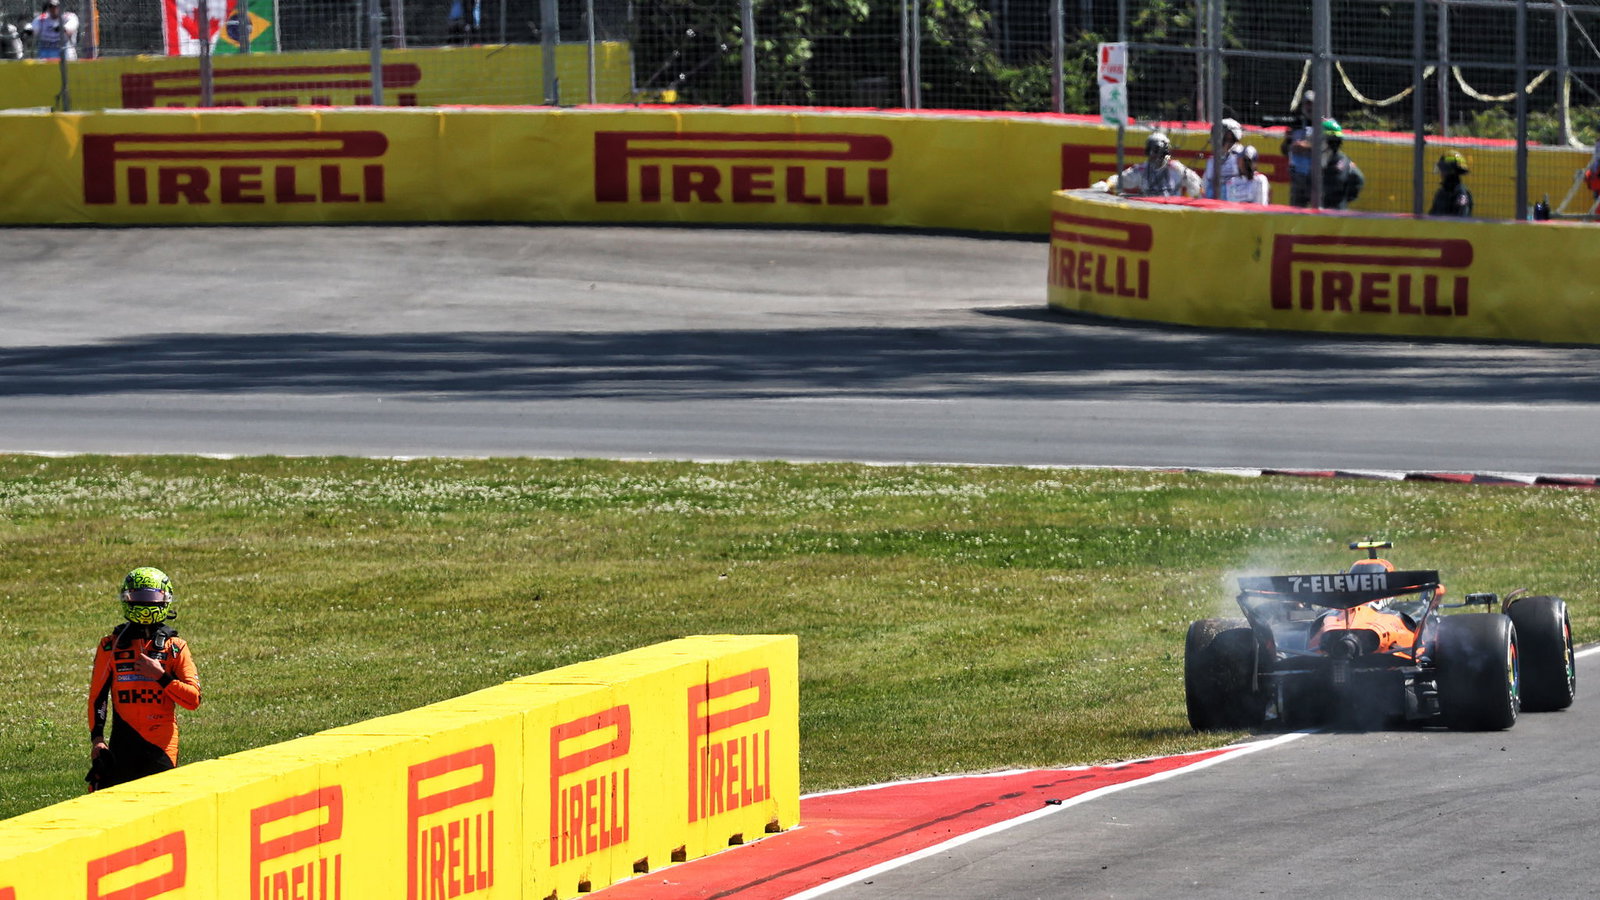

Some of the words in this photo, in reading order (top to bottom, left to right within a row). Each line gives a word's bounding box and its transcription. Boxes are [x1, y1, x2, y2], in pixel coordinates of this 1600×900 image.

[82, 131, 389, 205] PIRELLI
[594, 131, 893, 206] PIRELLI
[1271, 234, 1473, 317] PIRELLI
[118, 689, 163, 704] OKX
[550, 704, 631, 867] PIRELLI
[688, 667, 771, 824] PIRELLI
[407, 743, 496, 900] PIRELLI
